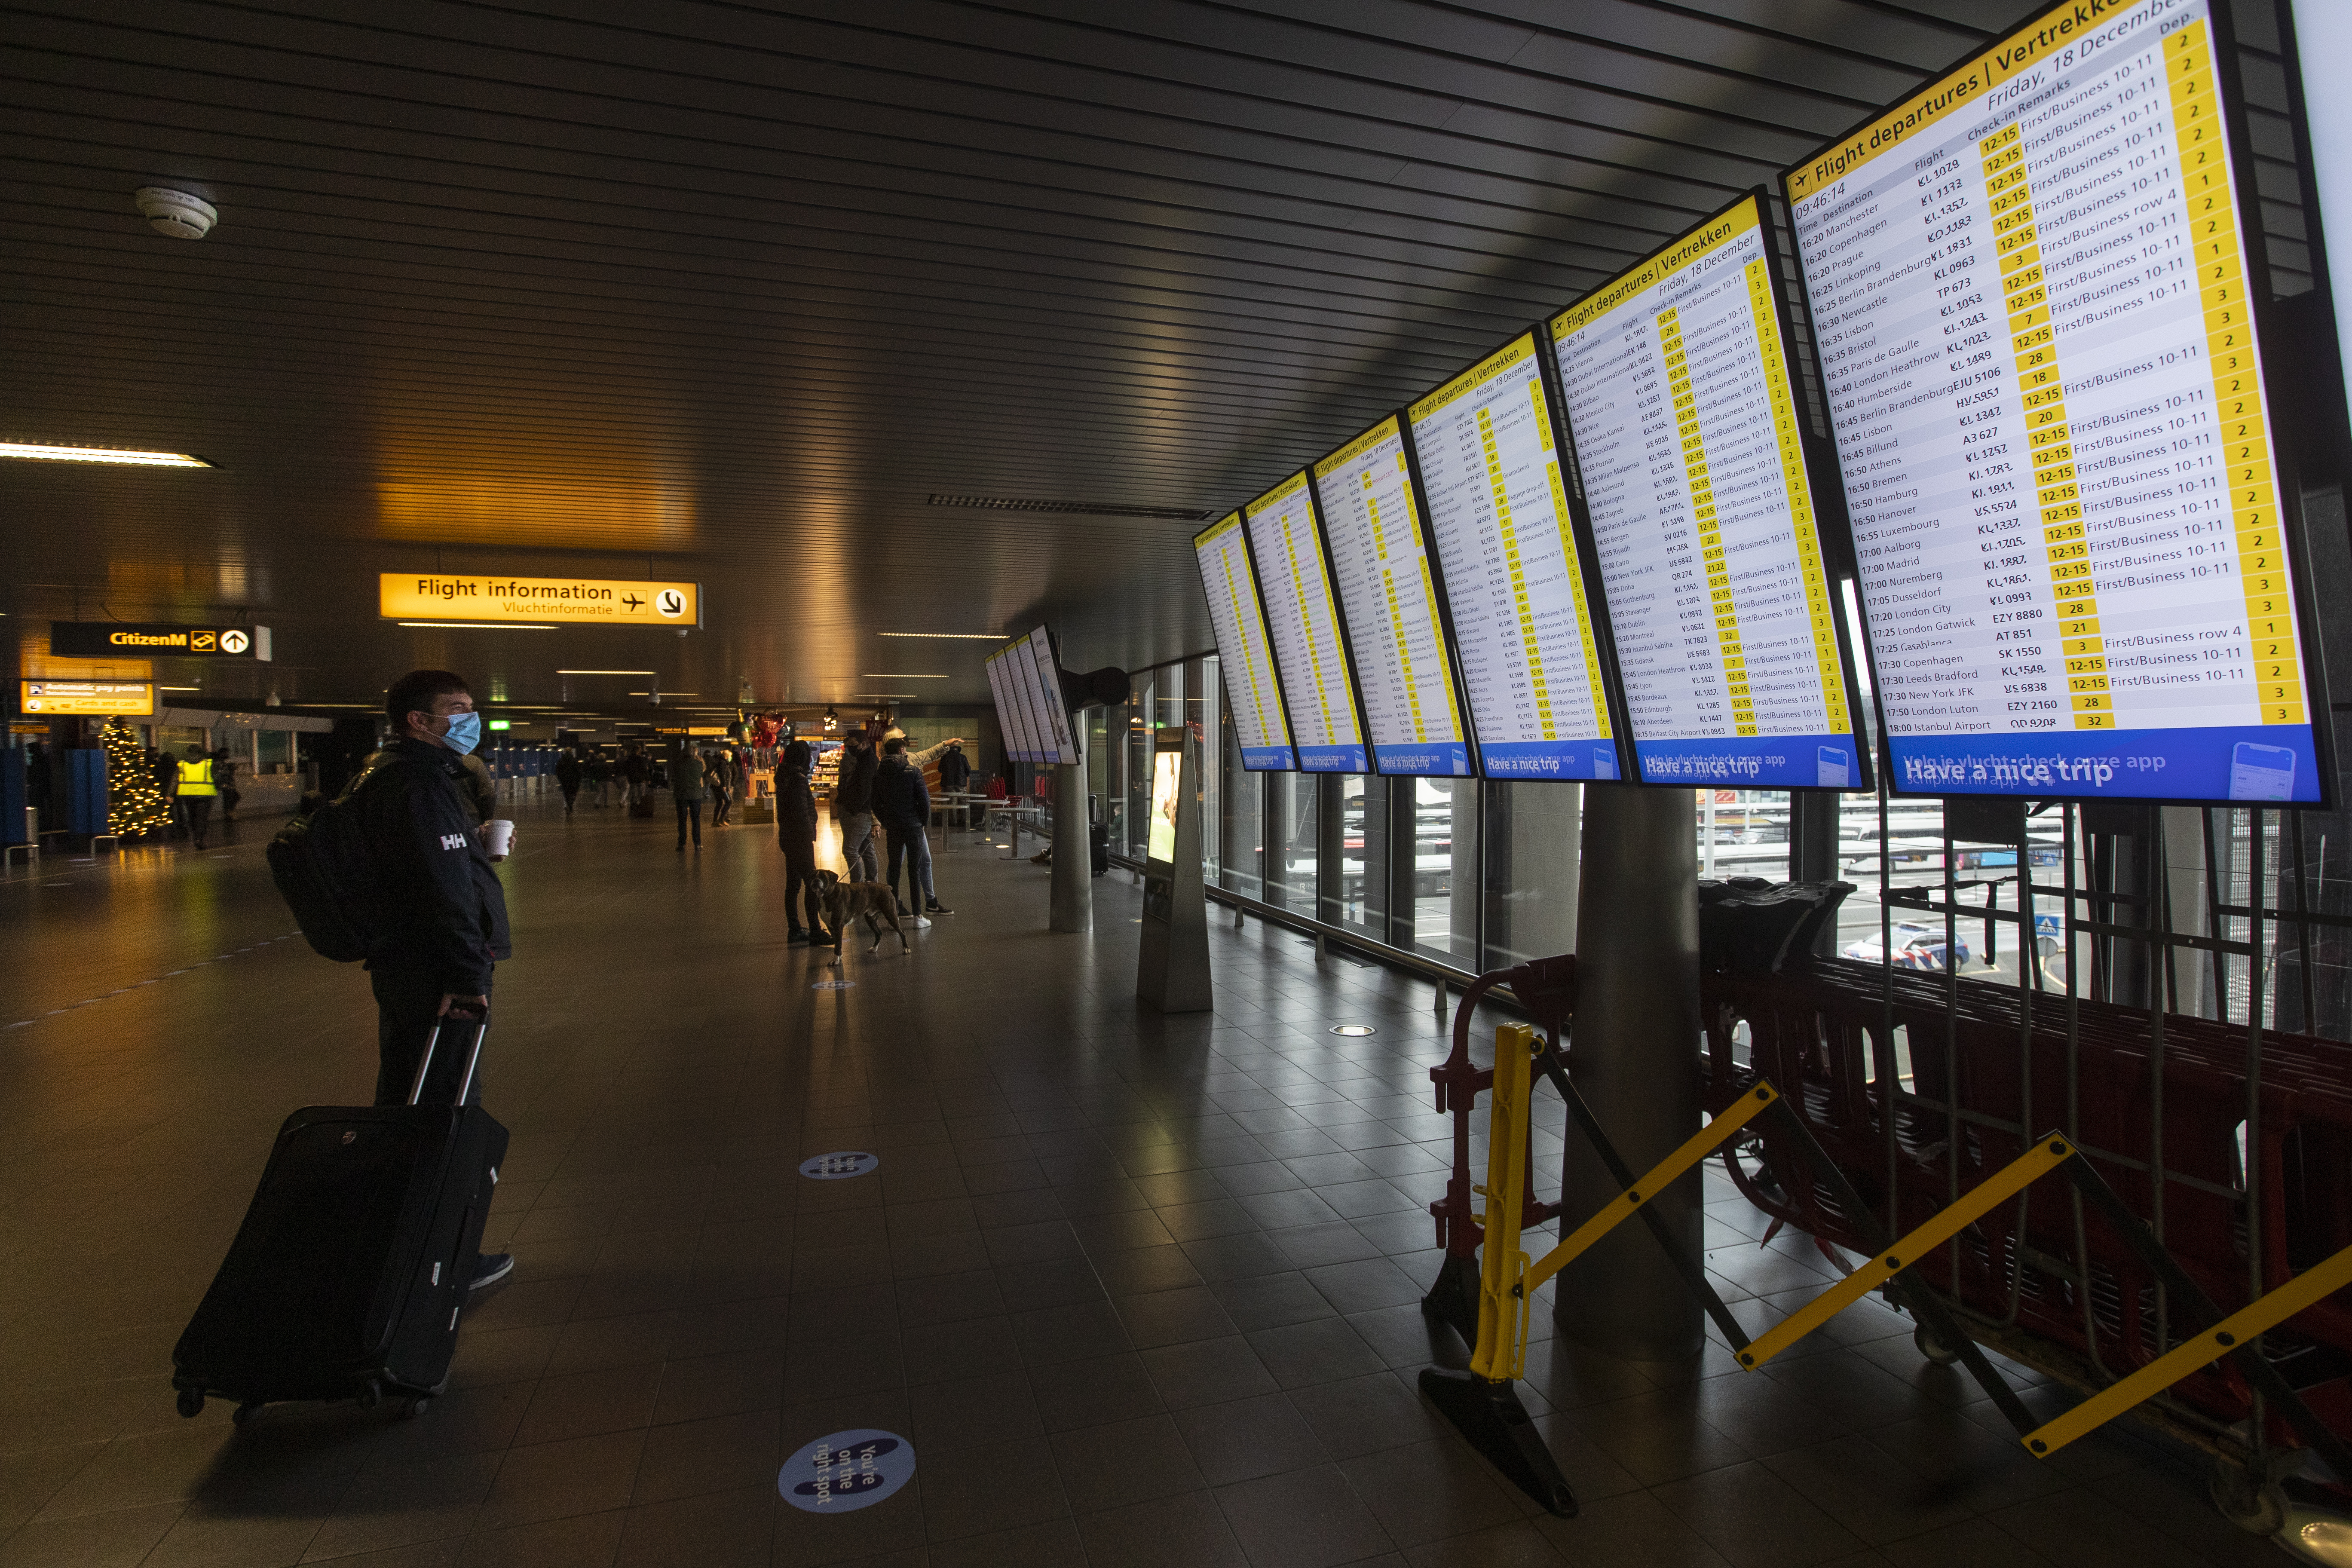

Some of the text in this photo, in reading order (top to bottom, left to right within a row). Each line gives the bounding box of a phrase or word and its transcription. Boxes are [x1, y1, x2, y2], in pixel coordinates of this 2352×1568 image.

[1988, 71, 2045, 111] Friday,
[2055, 50, 2073, 72] 18
[1795, 13, 2194, 238] Time Destination Flight Check-in Remarks Dep.
[1801, 34, 2188, 250] 16:20 Manchester 12-15 First/Business 10-11 2
[1815, 141, 1865, 182] Flight
[1870, 74, 1978, 149] departures
[1795, 181, 1845, 224] 09:46:14
[1817, 151, 2206, 333] 16:30 Newcastle KL 0963 12-15 First/Business 10-11 2
[1820, 174, 2209, 349] 16:35 Lisbon TP 673 3 First/Business row 4 1
[1566, 222, 1731, 329] Flight departures Vertrekken
[1659, 234, 1755, 297] Friday, 18 December
[1556, 331, 1585, 355] 09:46:14
[1418, 349, 1519, 416] Flight departures Vertrekken
[1476, 359, 1534, 399] Friday, 18 December
[1411, 418, 1432, 437] 09:46:15
[1417, 444, 1426, 453] 12:40
[1425, 435, 1442, 448] Liverpool
[1464, 417, 1473, 427] 7002
[1480, 410, 1486, 419] 28
[1844, 357, 2237, 479] 16:50 Athens A3 627 20 3
[1320, 426, 1389, 473] Flight departures Vertrekken
[1360, 436, 1399, 463] Friday, 18 December
[1250, 479, 1301, 514] Flight departures Vertrekken
[1205, 529, 1219, 540] departures
[1219, 518, 1235, 532] Vertrekken
[418, 580, 612, 600] Flight information
[1606, 542, 1810, 595] 15:05 Doha QR 274 21,22 3
[503, 602, 612, 615] Vluchtinformatie
[1872, 579, 2269, 638] 17:25 London Gatwick EZY 8880 28 3
[110, 632, 187, 646] CitizenM
[1644, 704, 1672, 714] Edinburgh
[1733, 699, 1751, 707] 12-15
[1752, 696, 1798, 706] First/Business
[1800, 694, 1819, 703] 10-11
[1831, 693, 1837, 701] 2
[1886, 687, 2284, 717] 17:50 London Luton EZY 2160 28 3
[440, 833, 467, 850] HH
[813, 1443, 834, 1505] right spot
[839, 1450, 856, 1489] on the
[861, 1445, 878, 1485] You're
